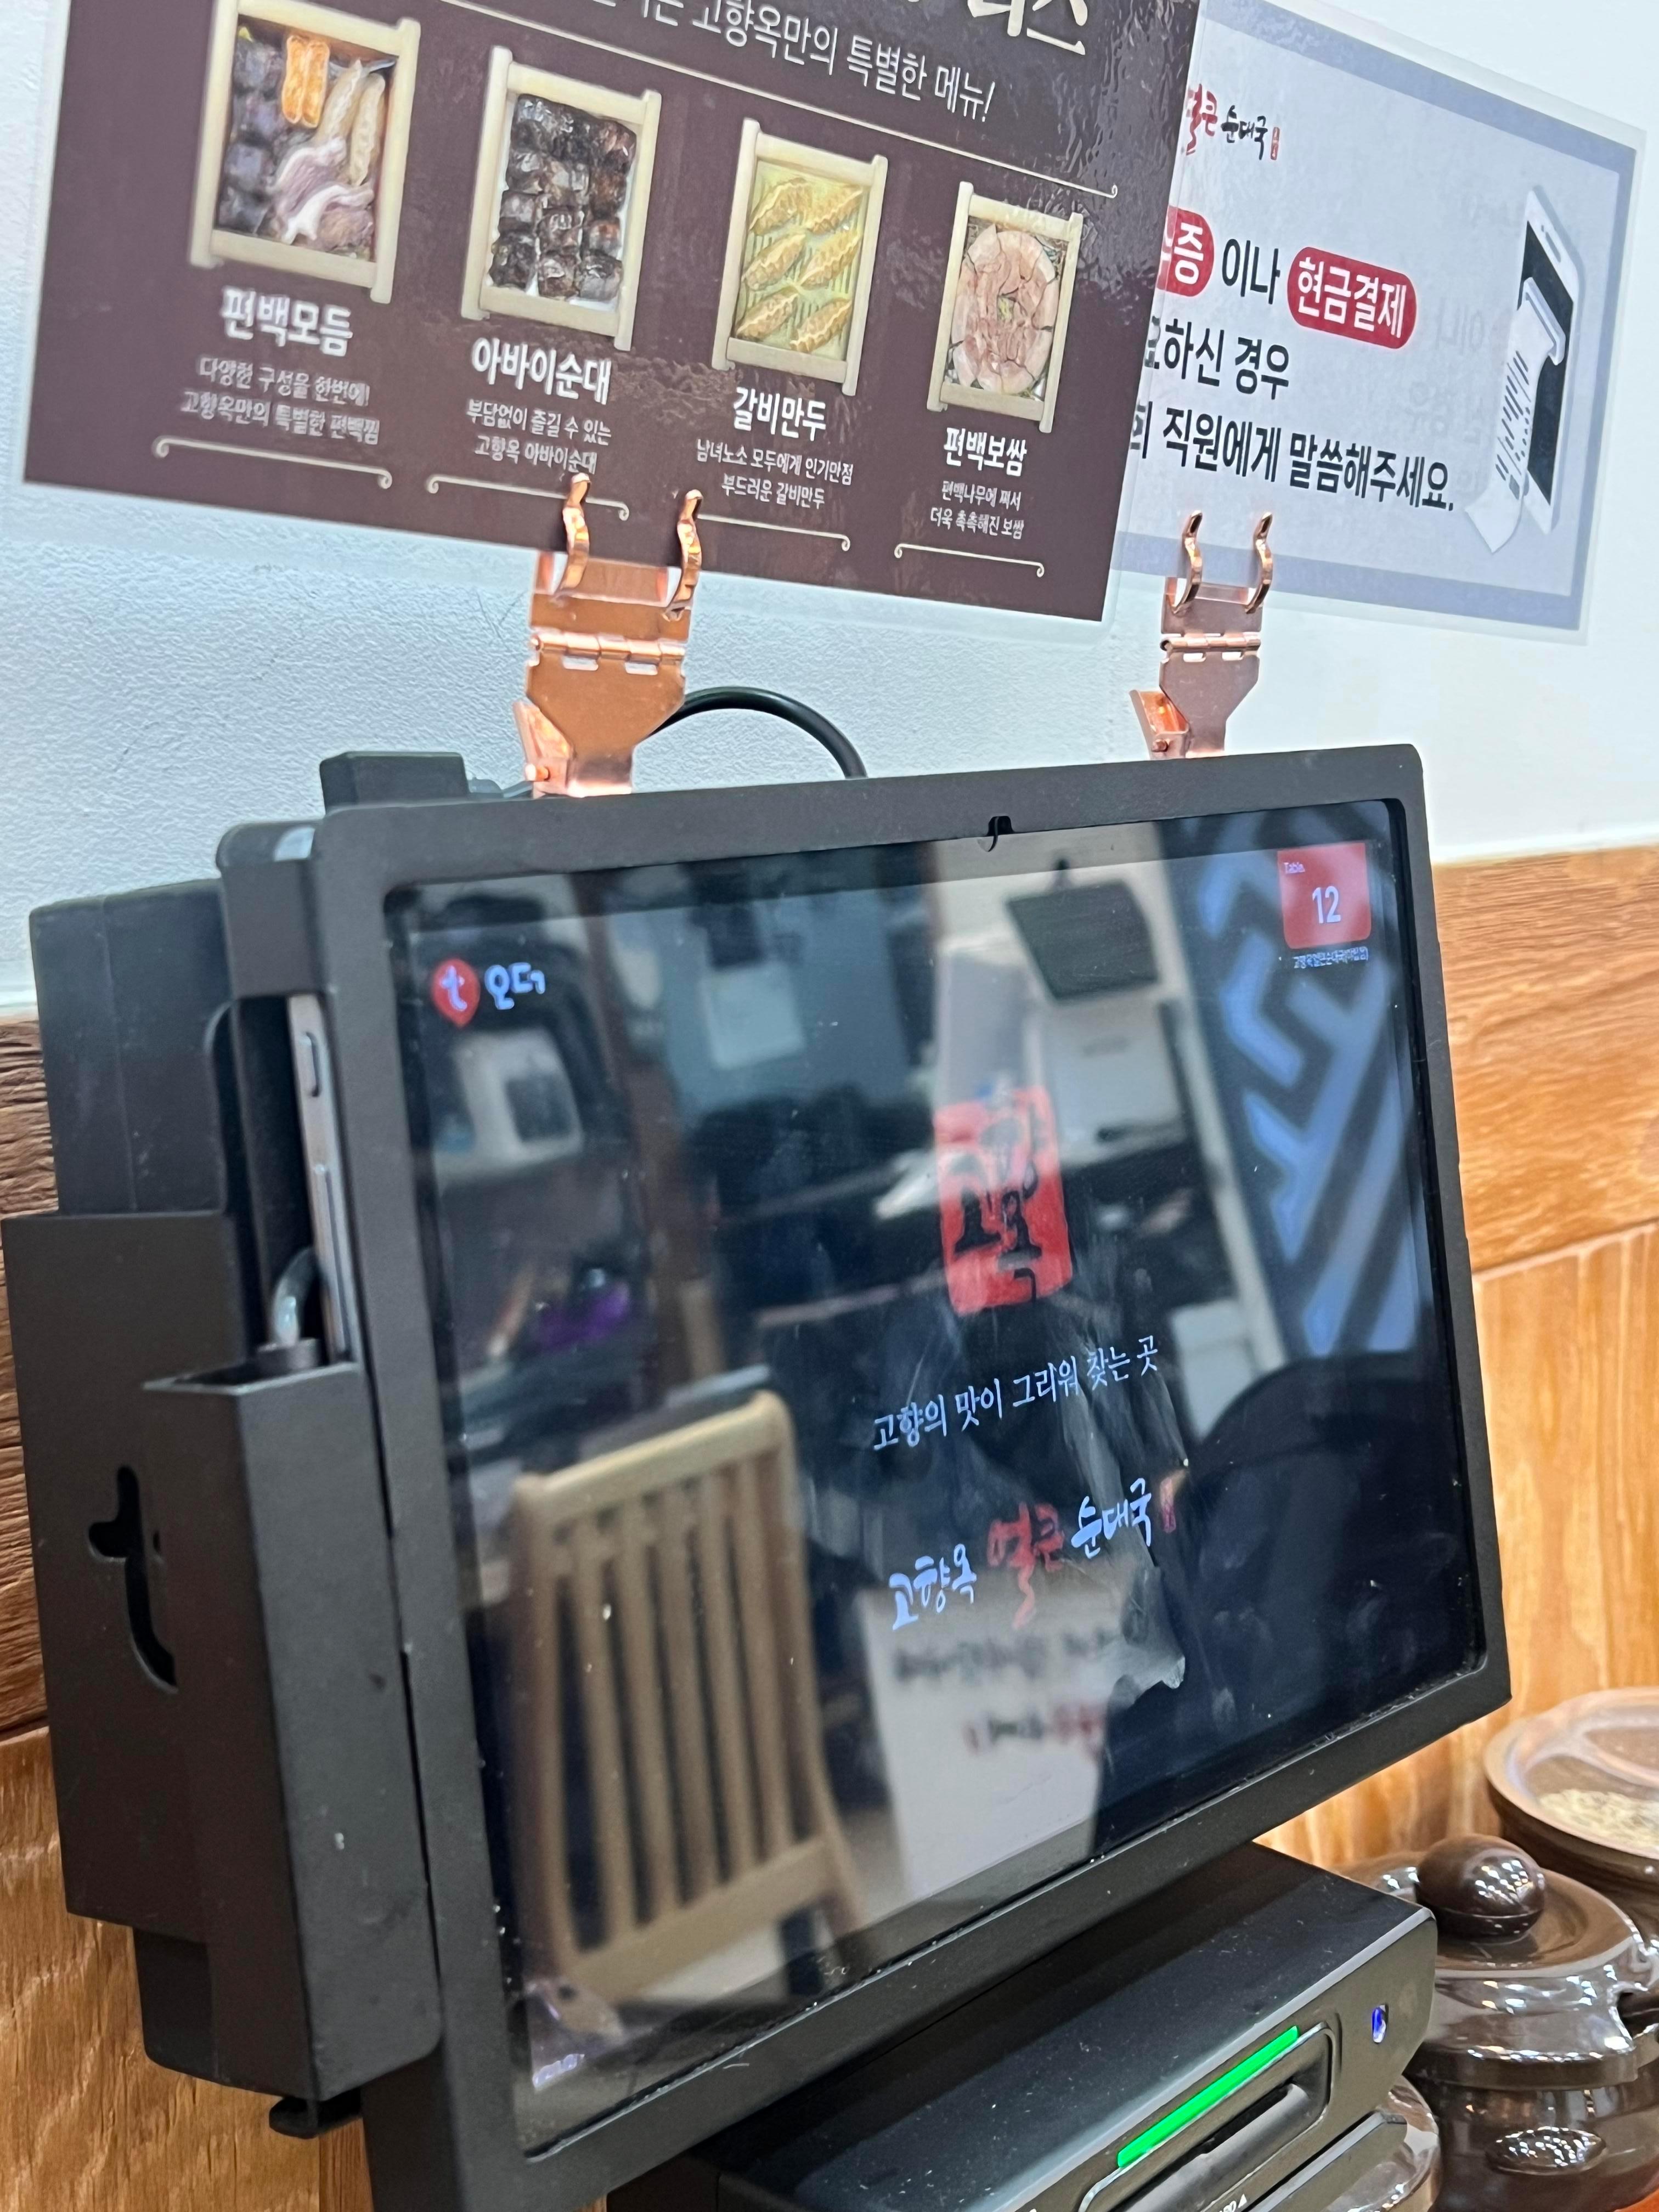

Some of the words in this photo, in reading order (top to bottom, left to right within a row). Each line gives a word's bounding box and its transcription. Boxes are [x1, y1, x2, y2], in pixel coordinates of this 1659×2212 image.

[847, 34, 927, 101] 특별한
[935, 66, 996, 122] 메뉴!
[1220, 105, 1268, 161] 순대국
[1222, 238, 1281, 305] 이나
[1297, 257, 1407, 338] 현금결제
[221, 287, 354, 357] 편백모듬
[199, 357, 253, 390] 다양한
[258, 366, 311, 399] 구성을
[472, 337, 612, 405] 아바이순대
[1234, 336, 1289, 400] 경우
[180, 391, 272, 428] 고향옥만의
[275, 403, 326, 437] 특별한
[466, 399, 528, 431] 부담없이
[531, 408, 562, 438] 즐길
[564, 415, 579, 440] 수
[583, 419, 612, 446] 있는
[733, 386, 827, 441] 갈비만두
[474, 435, 521, 465] 고향옥
[524, 442, 597, 475] 아바이순대
[697, 438, 748, 466] 남녀노소
[750, 448, 803, 476] 모두에게
[805, 458, 854, 486] 인기만점
[943, 427, 1028, 477] 편백보쌈
[1163, 407, 1282, 482] 직원에게
[1289, 432, 1454, 512] 말씀해주세요.
[721, 472, 772, 503] 부드러운
[776, 482, 825, 510] 갈비만두
[941, 480, 998, 508] 편백나무에
[930, 506, 953, 531] 더욱
[955, 509, 1001, 537] 촉촉해진
[1001, 517, 1025, 540] 보쌈
[1312, 885, 1341, 924] 12
[873, 1393, 947, 1451] 고향의
[955, 1378, 1003, 1431] 맛이
[1012, 1355, 1080, 1408] 그리워
[1086, 1346, 1131, 1391] 찾는
[1136, 1335, 1158, 1376] 곳
[889, 1543, 977, 1631] 고향옥
[1070, 1477, 1152, 1559] 순대국
